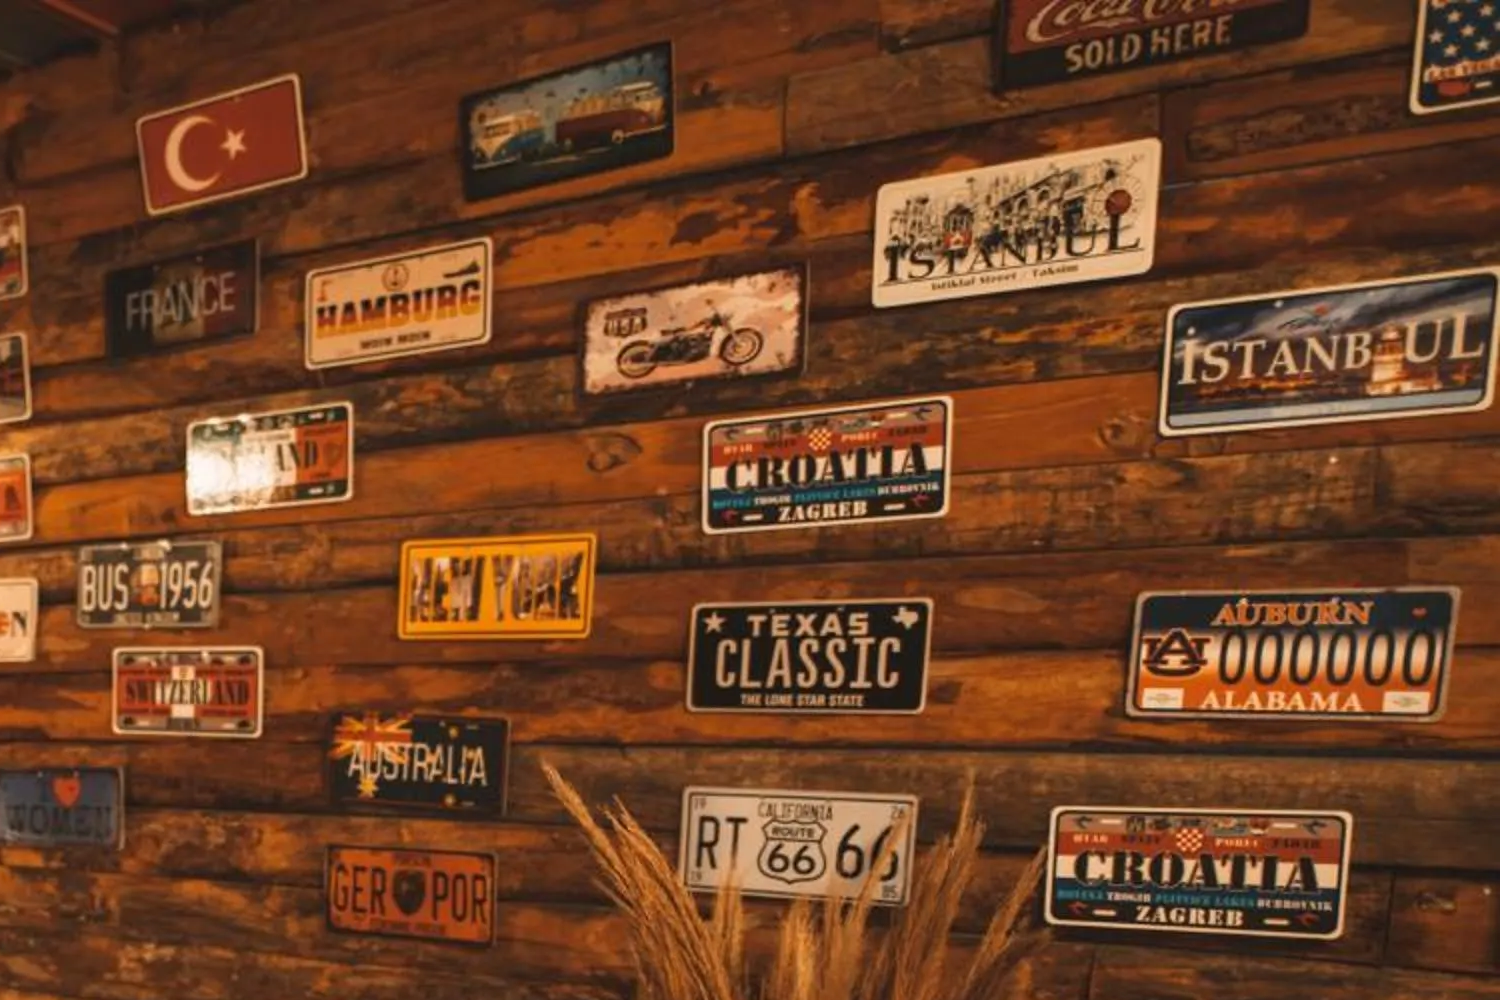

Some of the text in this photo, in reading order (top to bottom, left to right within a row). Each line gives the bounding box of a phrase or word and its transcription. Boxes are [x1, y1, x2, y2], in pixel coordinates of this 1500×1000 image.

[1065, 14, 1233, 73] SOLD HERE
[126, 272, 236, 332] FRANCE
[315, 280, 482, 339] HAMBURG
[726, 443, 928, 493] CROATIA
[778, 500, 868, 523] ZAGREB
[81, 561, 214, 612] BUS 1956
[409, 551, 584, 622] NEW YORK
[747, 612, 870, 637] TEXAS
[1211, 600, 1375, 627] AUBURN
[714, 636, 901, 689] CLASSIC
[126, 678, 250, 706] SWITZERLAND
[740, 693, 865, 708] THE LONE STAR STATE
[1199, 690, 1364, 713] ALABAMA
[348, 741, 488, 787] AUSTRALIA
[758, 801, 834, 821] CALIFORNIA
[771, 826, 816, 838] ROUTE
[695, 815, 749, 871] RT
[767, 843, 817, 875] 66
[1074, 850, 1321, 893] CROATIA
[333, 863, 488, 925] GER POR
[1136, 905, 1244, 927] ZAGREB
